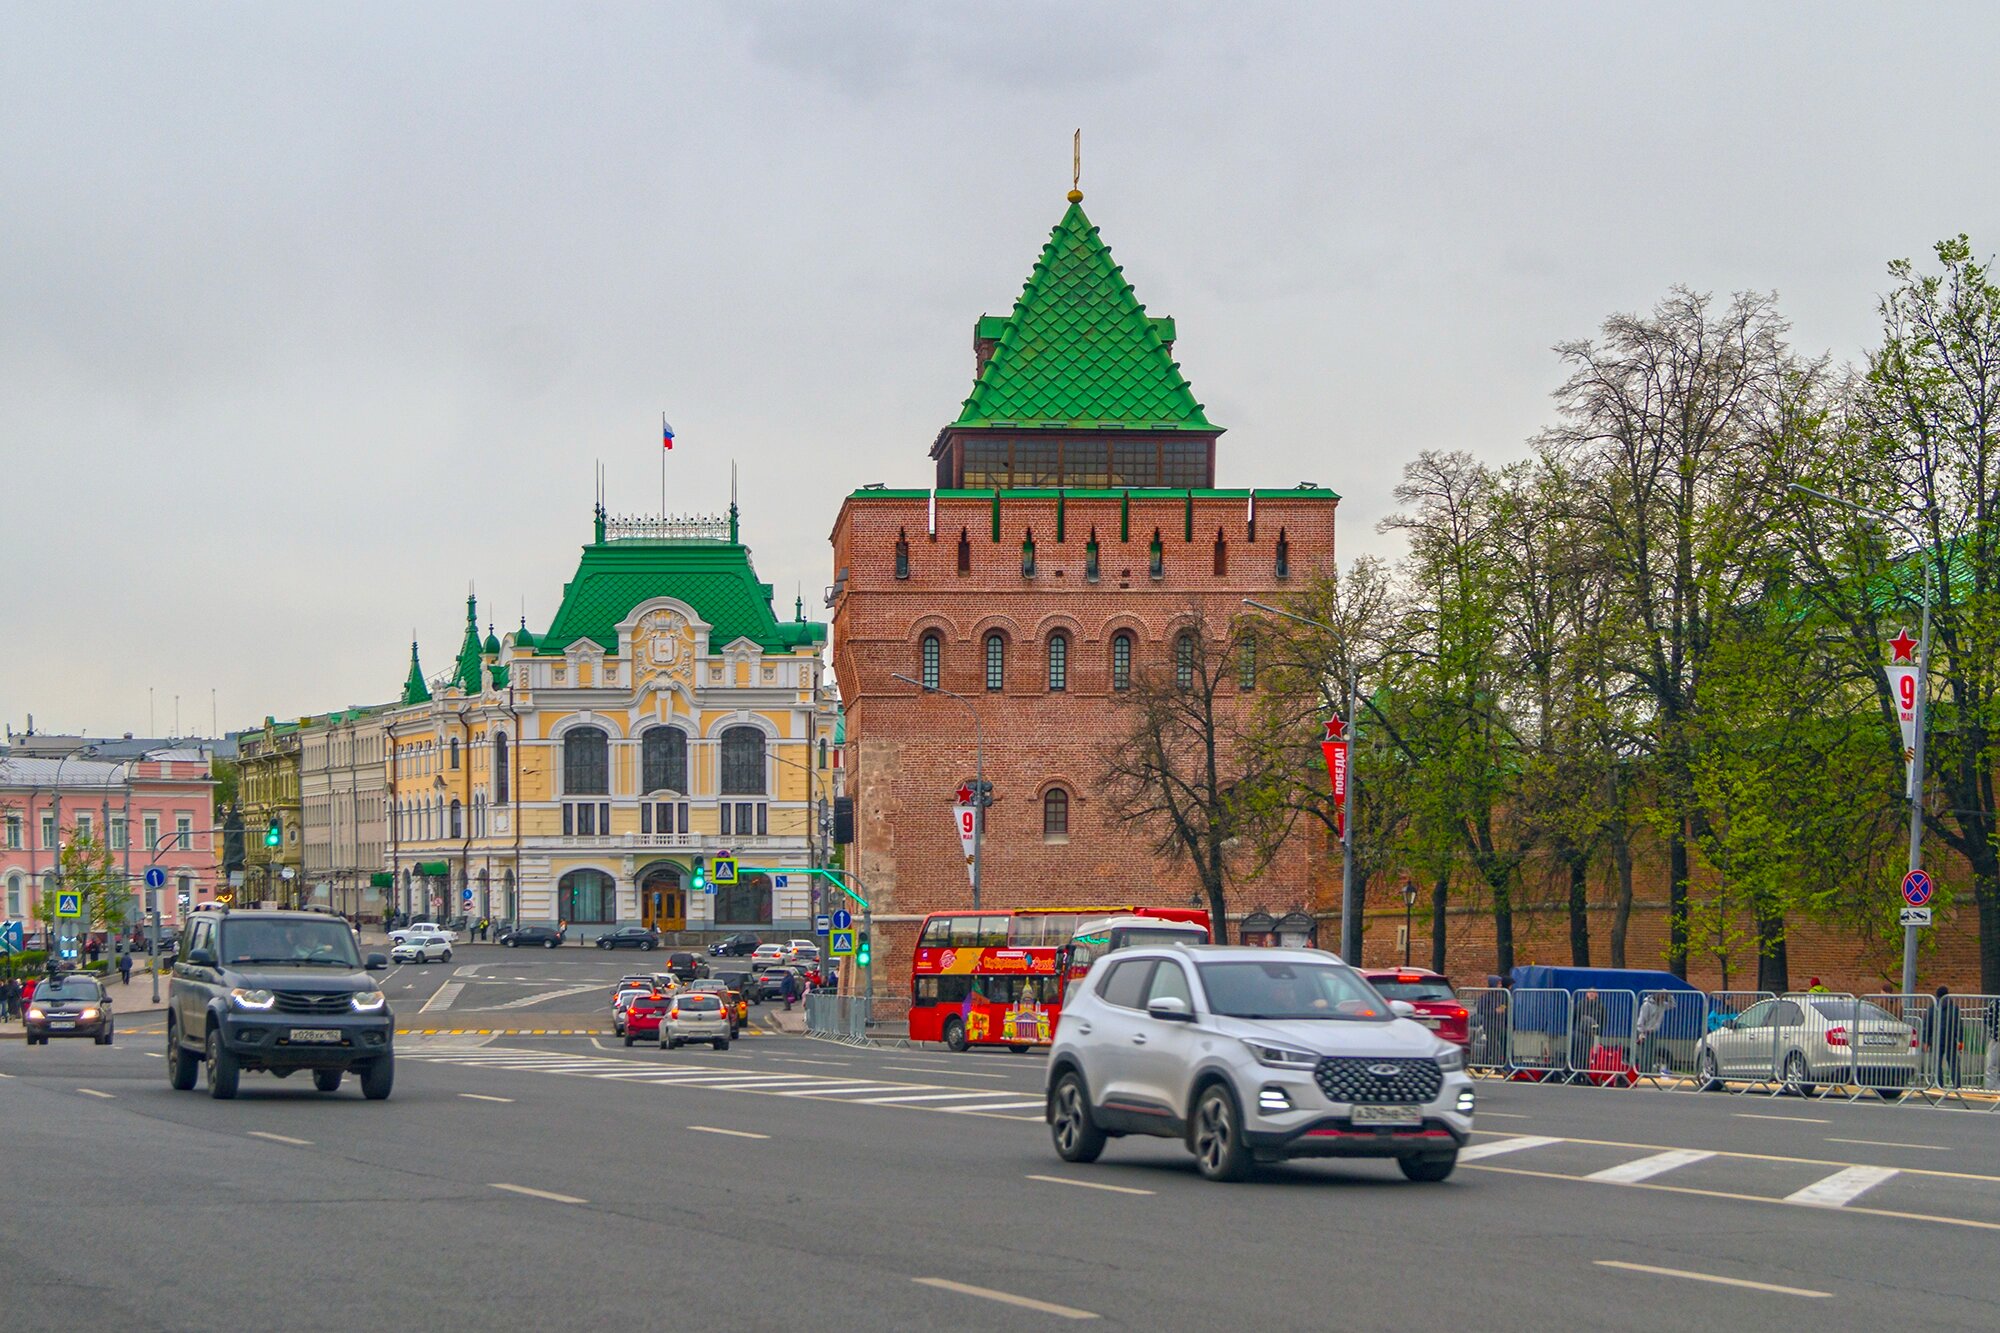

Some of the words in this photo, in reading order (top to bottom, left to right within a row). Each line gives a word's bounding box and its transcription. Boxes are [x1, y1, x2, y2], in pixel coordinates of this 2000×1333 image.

[1900, 675, 1914, 710] 9
[1334, 748, 1346, 795] ПОБЕДА!
[962, 812, 973, 833] 9
